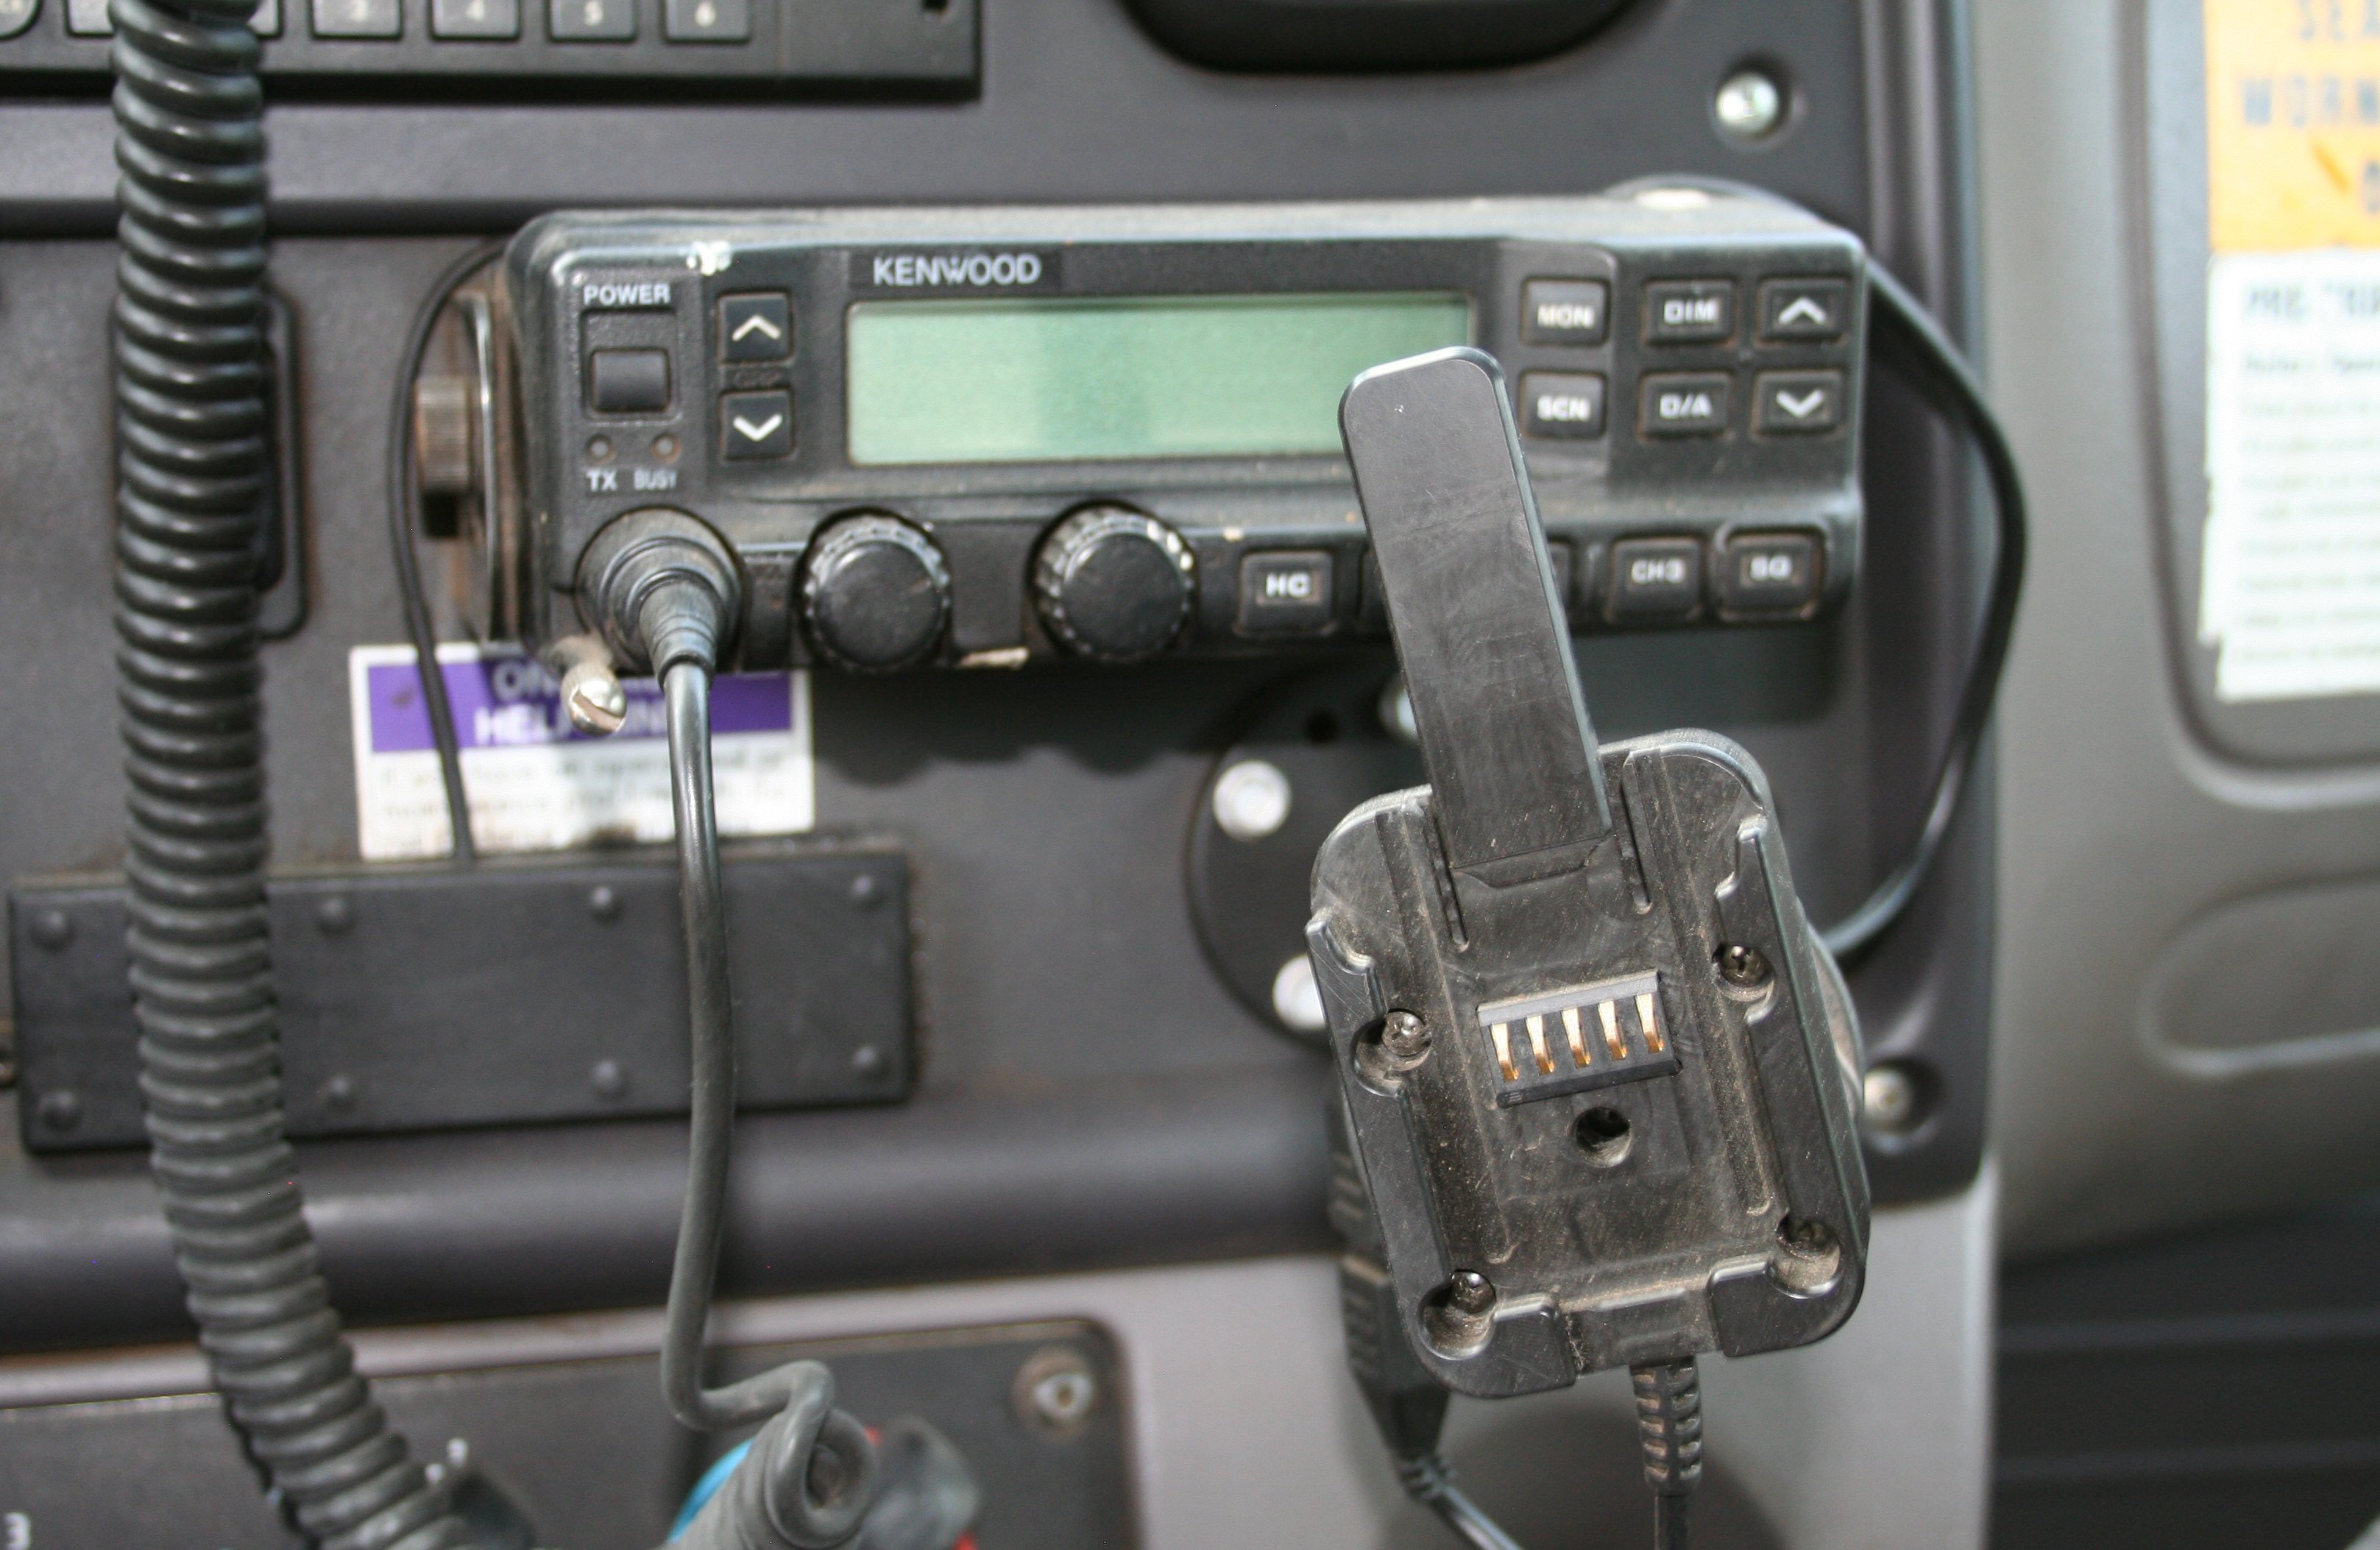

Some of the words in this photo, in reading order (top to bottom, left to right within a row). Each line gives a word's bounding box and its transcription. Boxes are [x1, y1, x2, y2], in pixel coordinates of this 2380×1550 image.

[872, 253, 1042, 286] KENWOOD
[584, 284, 671, 305] POWER
[1537, 303, 1596, 329] MON
[1662, 297, 1720, 325] DIM
[1536, 394, 1591, 422] SCN
[1659, 392, 1713, 420] D/A
[586, 468, 618, 492] TX
[634, 469, 677, 491] BUSY
